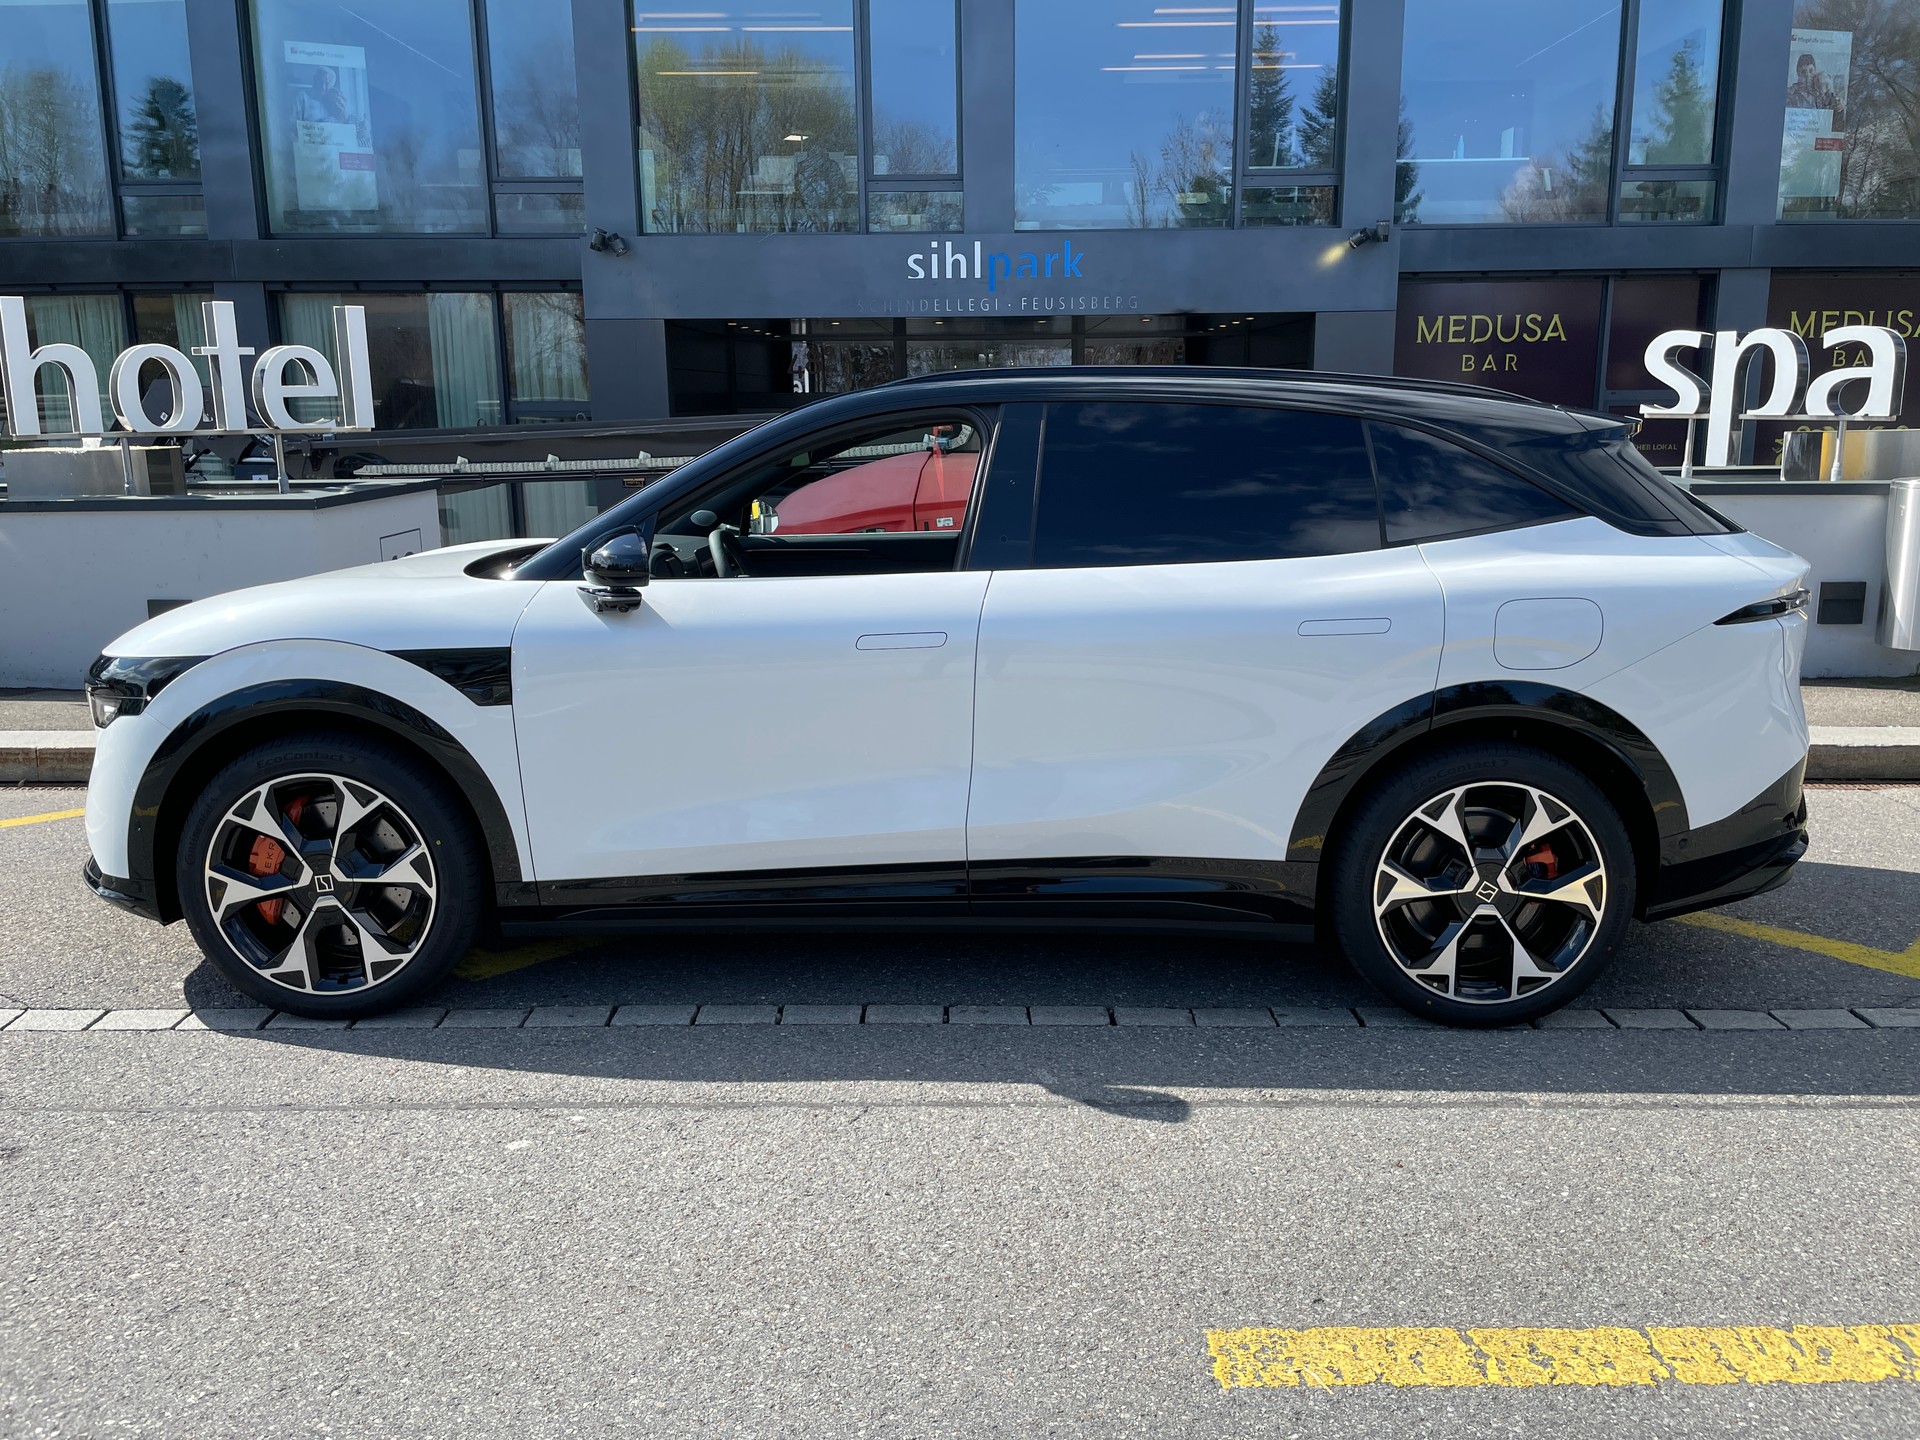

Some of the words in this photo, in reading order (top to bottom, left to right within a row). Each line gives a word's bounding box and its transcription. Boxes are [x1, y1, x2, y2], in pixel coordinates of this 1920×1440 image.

[906, 240, 1084, 293] sihlpark
[857, 298, 998, 313] SCHINDELLEGI
[1021, 296, 1138, 311] FEUSISBERG
[1415, 313, 1567, 344] MEDUSA
[0, 296, 375, 436] hotel
[1461, 353, 1518, 372] BAR
[1832, 349, 1868, 367] BA
[1639, 325, 1907, 467] spa
[256, 751, 345, 769] EcoContact
[262, 842, 277, 878] EEKR
